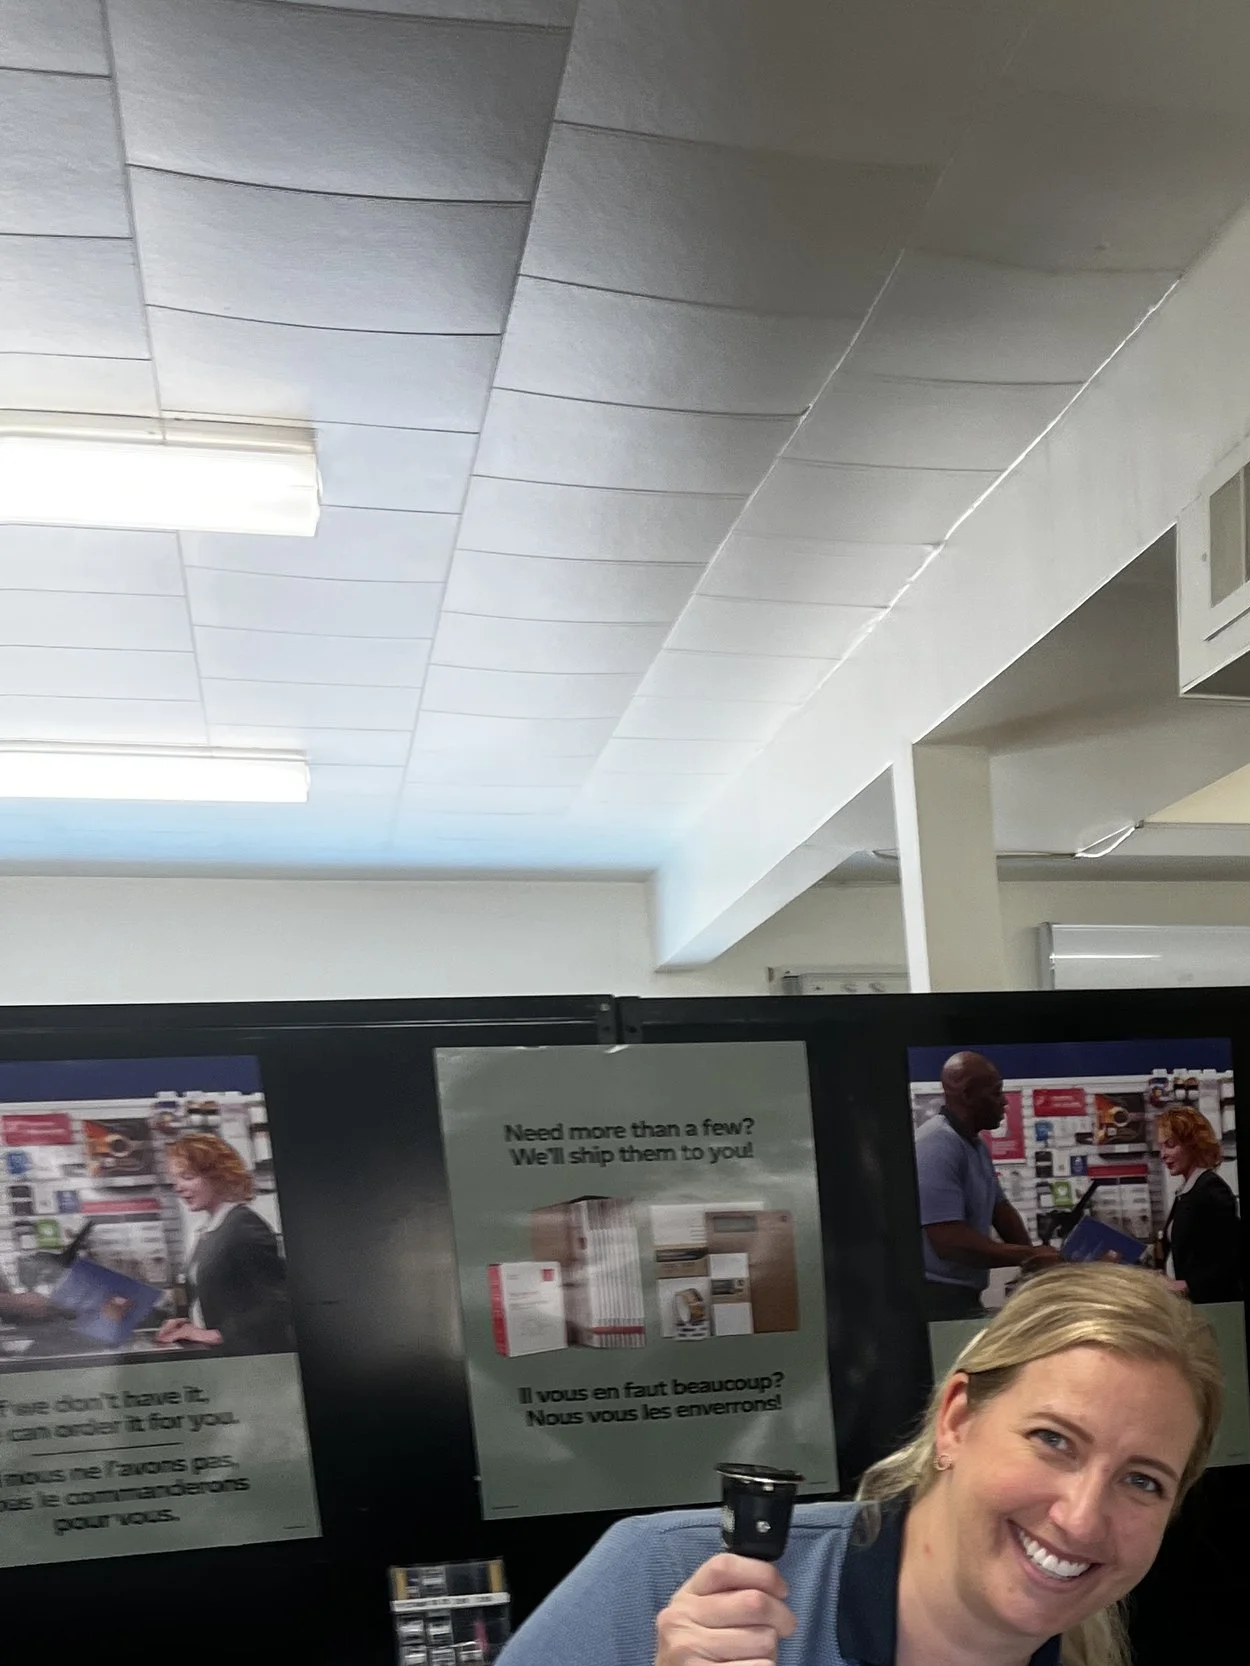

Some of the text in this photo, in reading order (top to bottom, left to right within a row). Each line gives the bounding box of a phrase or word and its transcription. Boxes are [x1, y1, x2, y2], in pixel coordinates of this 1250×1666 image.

[504, 1117, 755, 1142] Need more than a few?
[509, 1141, 754, 1167] We'll ship them to you!
[517, 1371, 785, 1404] Il vous en faut beaucoup?
[526, 1394, 782, 1427] Nous vous les enverrons!
